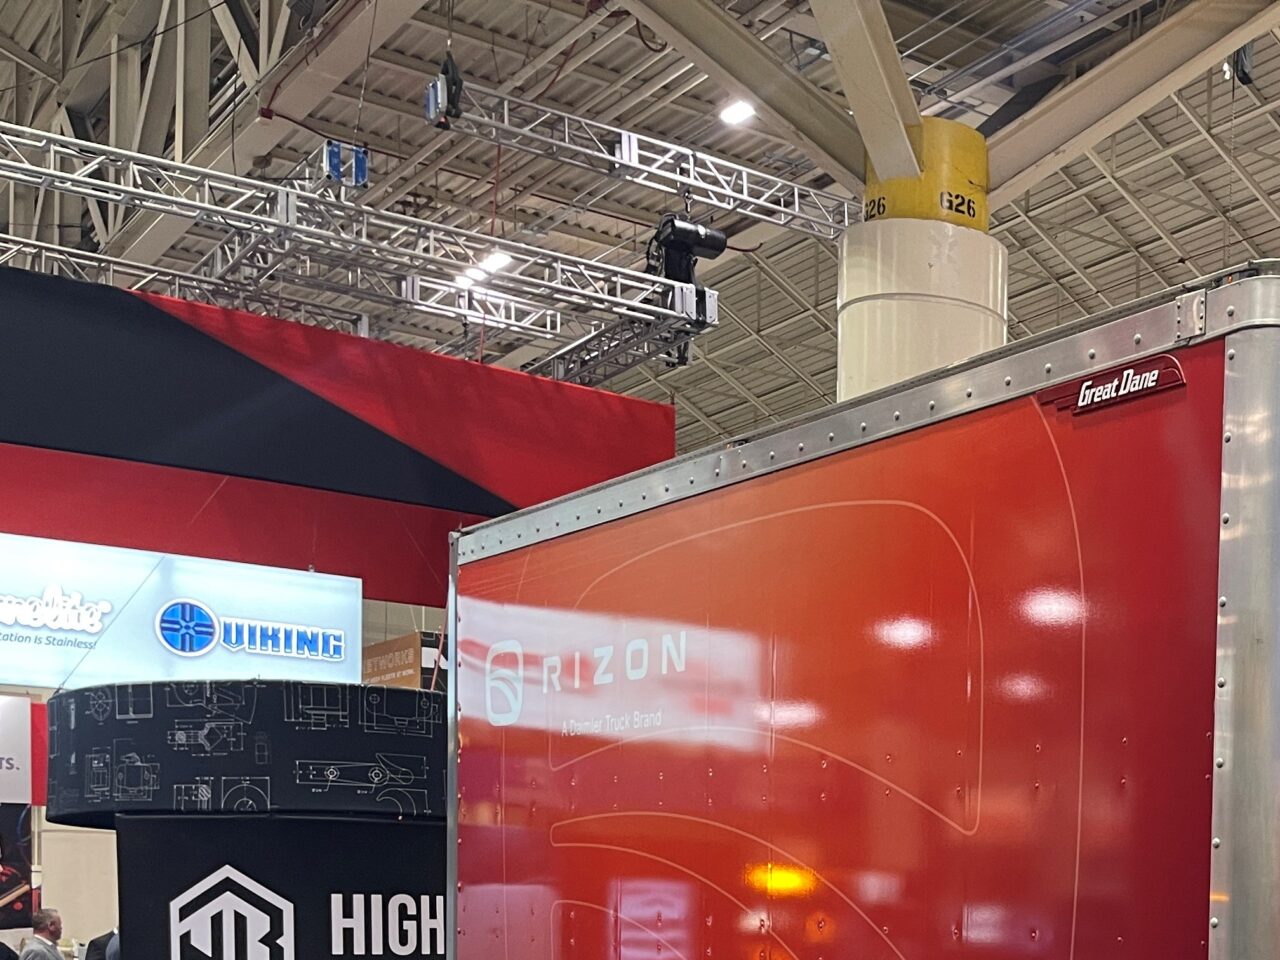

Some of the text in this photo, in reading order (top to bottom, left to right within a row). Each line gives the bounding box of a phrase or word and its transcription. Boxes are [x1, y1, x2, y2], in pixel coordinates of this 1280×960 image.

[940, 191, 976, 218] G26
[1078, 368, 1159, 407] Great Dane
[33, 635, 43, 645] Is
[44, 636, 97, 650] Stainless!
[220, 617, 345, 661] VIKING
[543, 631, 687, 694] RIZON
[570, 717, 602, 736] Daimler
[604, 713, 630, 731] Truck
[633, 708, 662, 729] Brand
[330, 893, 445, 955] HIGH
